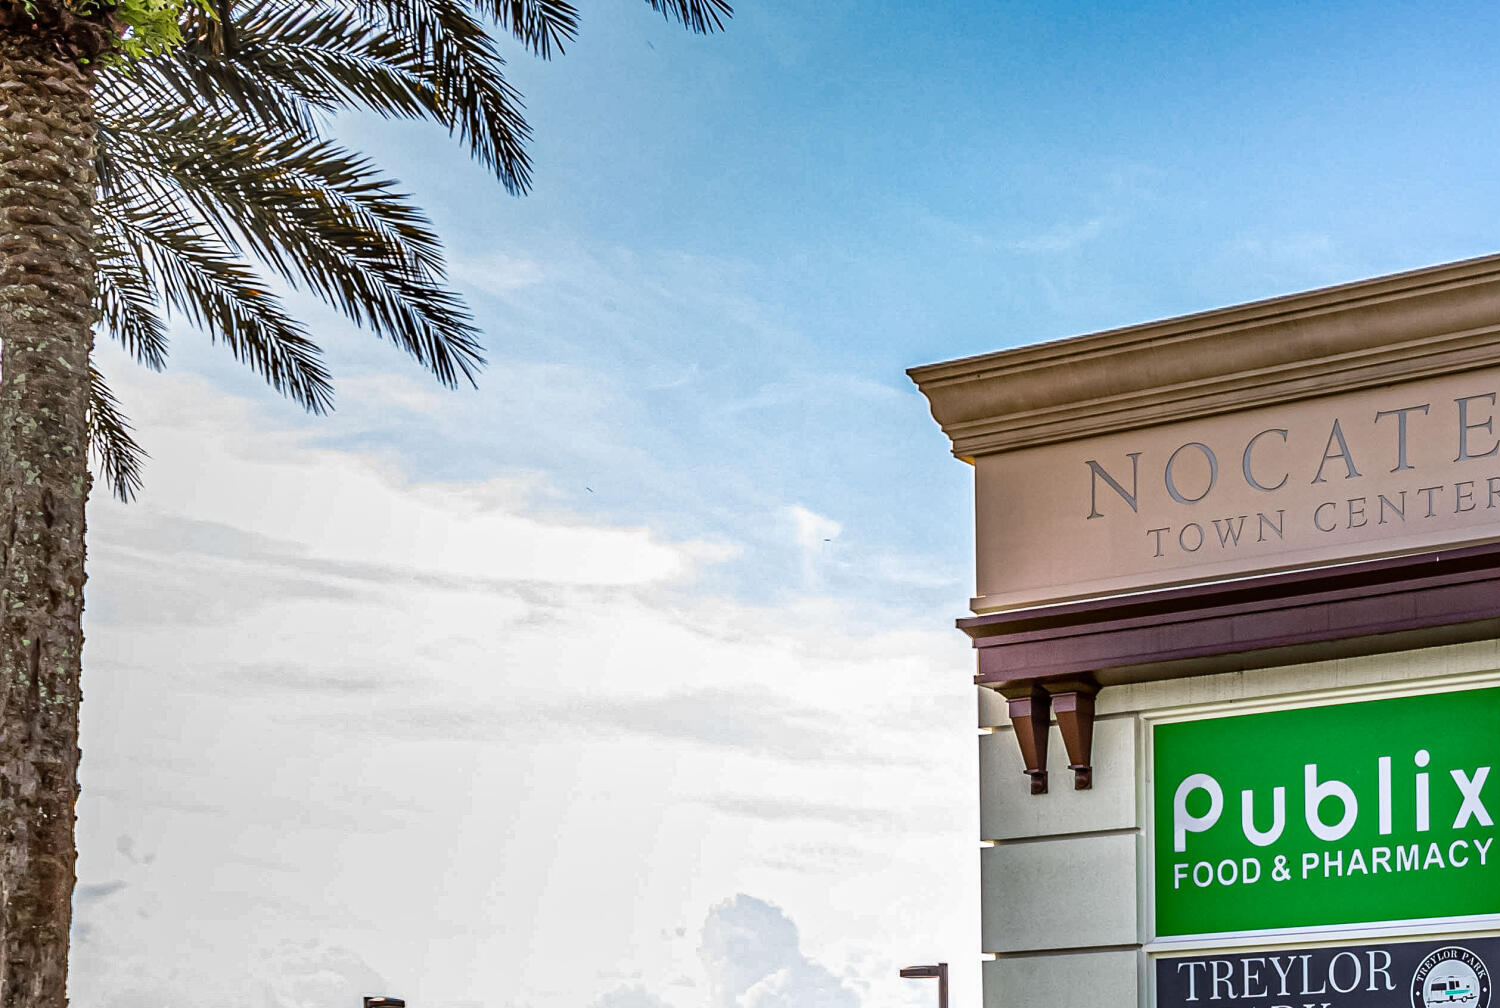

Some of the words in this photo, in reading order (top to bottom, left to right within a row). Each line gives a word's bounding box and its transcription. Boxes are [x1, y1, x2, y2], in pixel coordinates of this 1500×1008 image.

[1146, 509, 1285, 558] TOWN
[1173, 749, 1494, 853] Publix
[1173, 858, 1261, 889] FOOD
[1271, 854, 1291, 882] &
[1302, 838, 1494, 880] PHARMACY
[1177, 950, 1397, 1001] TREYLOR
[1416, 950, 1458, 982] TREYLOR
[1461, 952, 1487, 980] PARK
